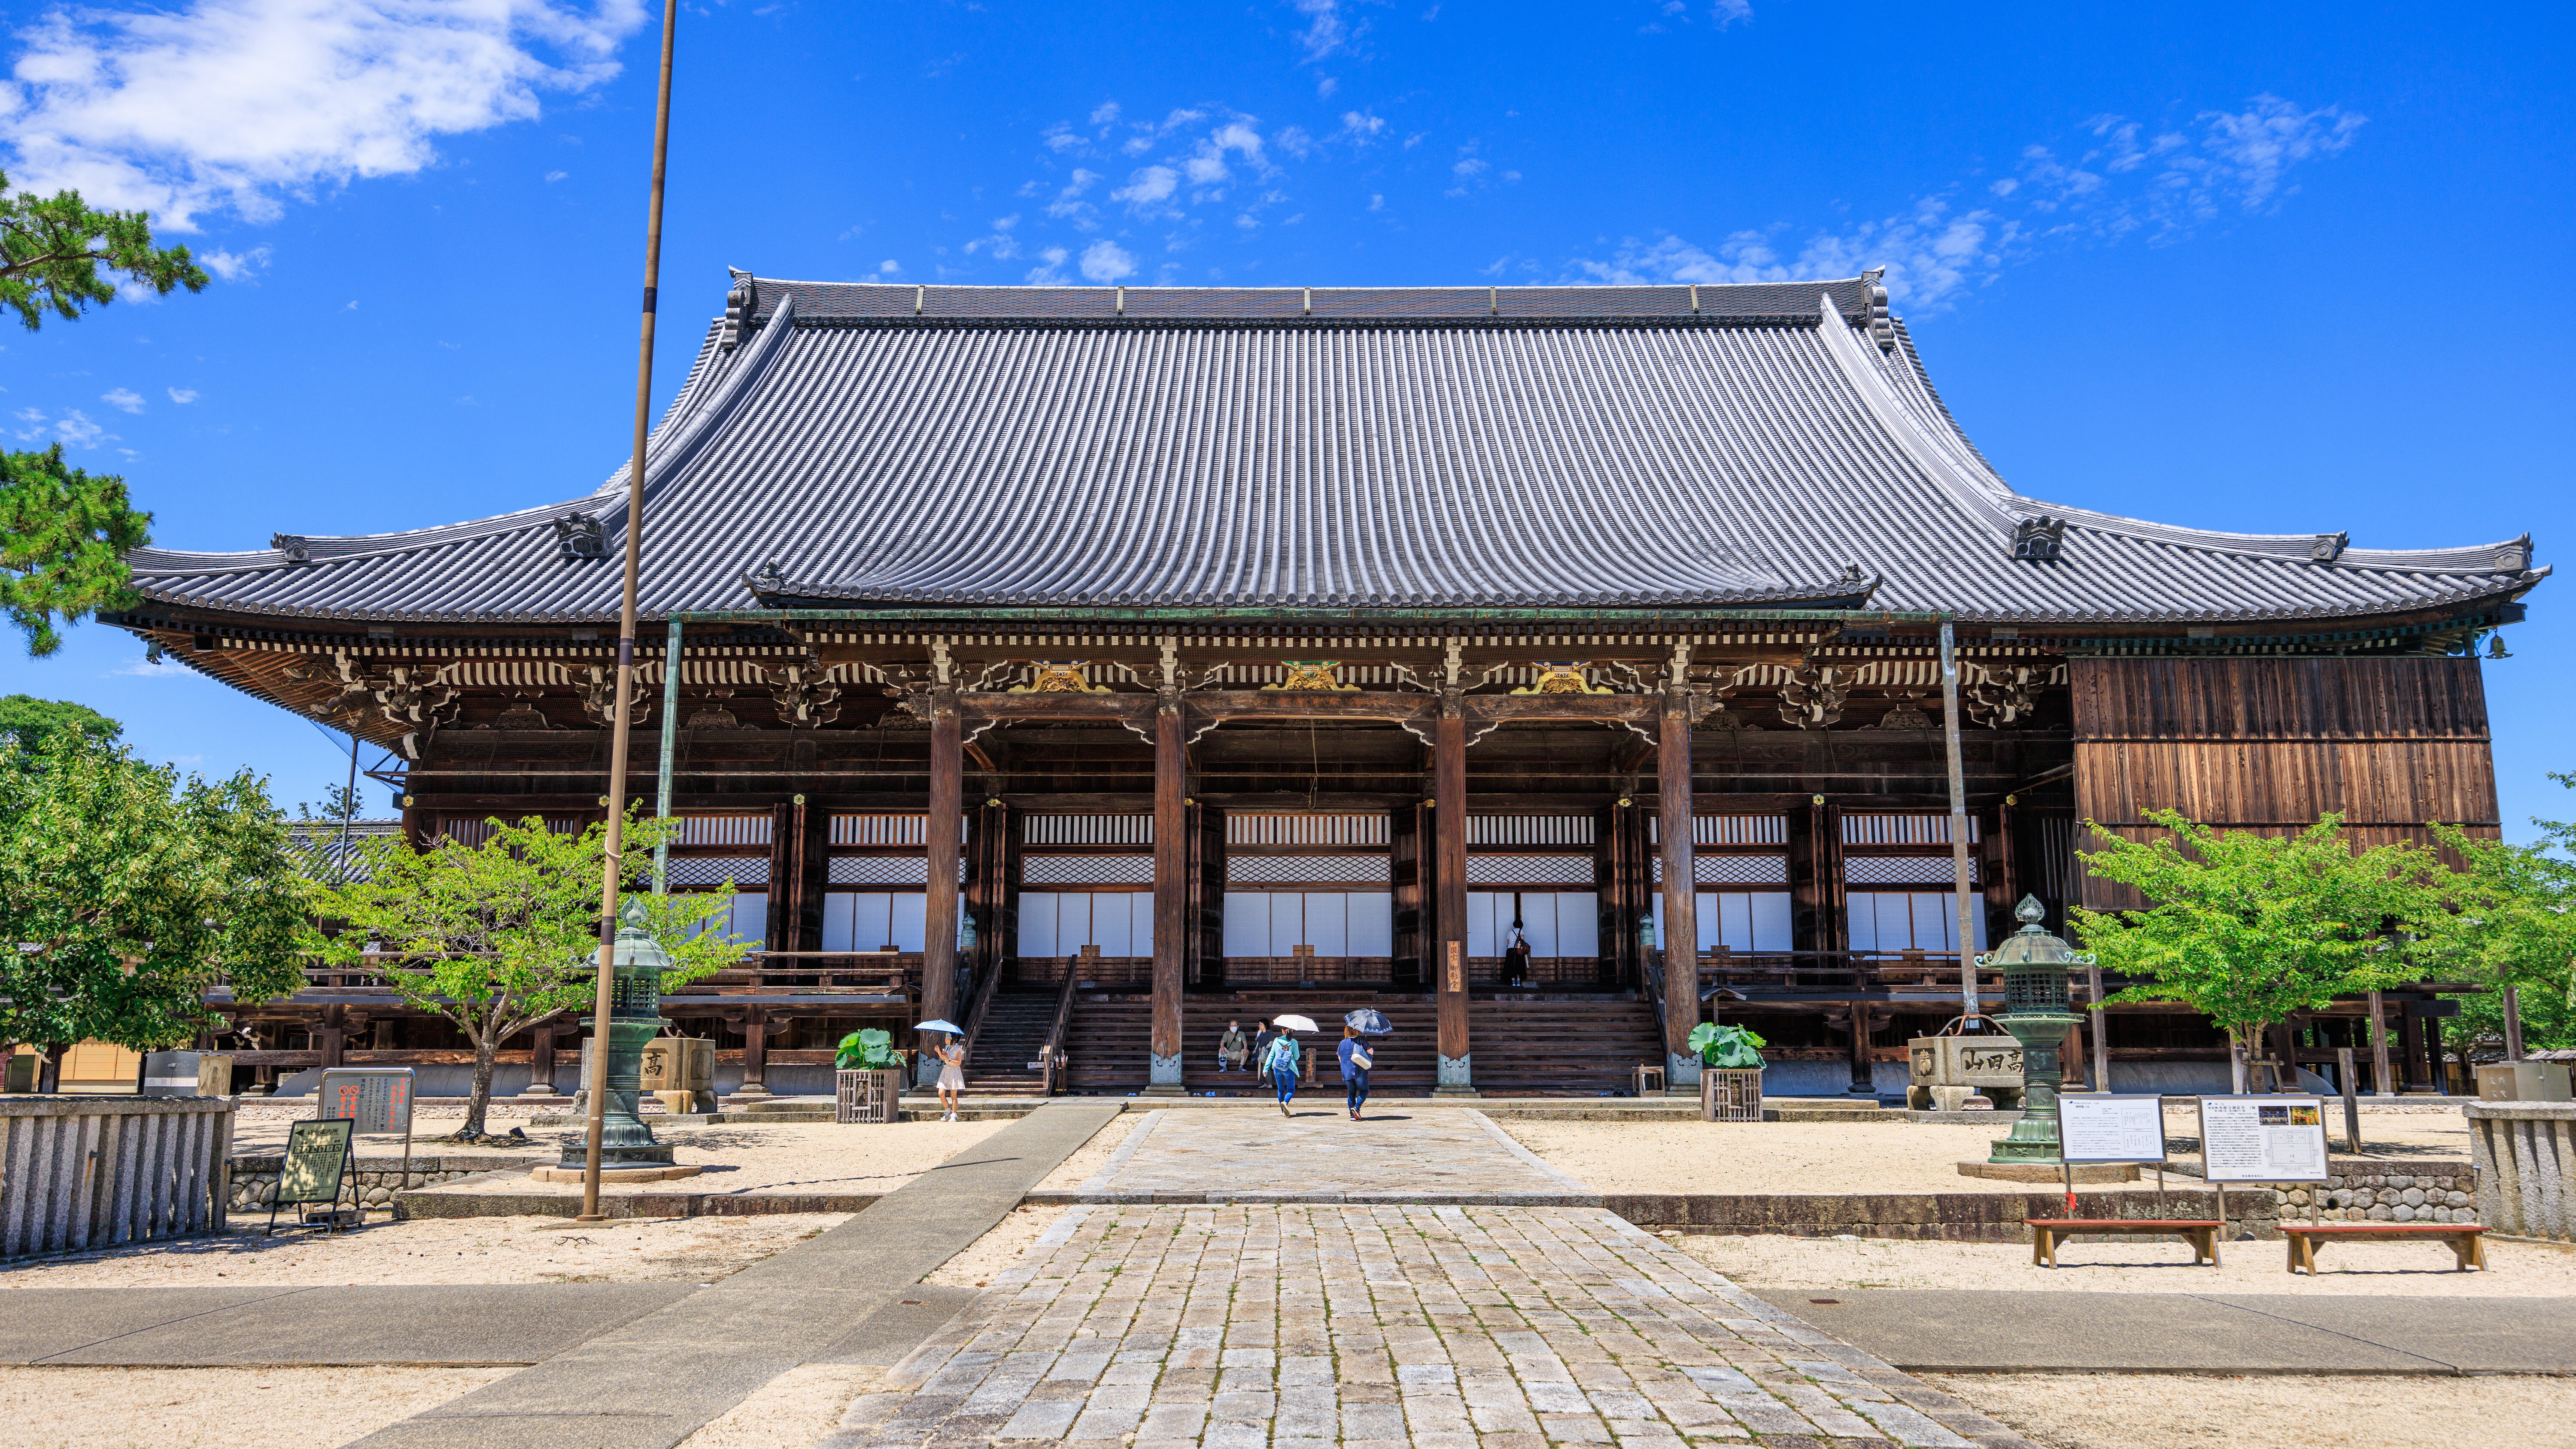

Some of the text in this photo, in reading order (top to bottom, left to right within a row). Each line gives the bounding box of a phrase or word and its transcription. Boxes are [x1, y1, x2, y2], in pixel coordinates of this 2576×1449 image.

[1450, 947, 1457, 961] 国宝
[389, 1085, 398, 1131] 火災から守ろう
